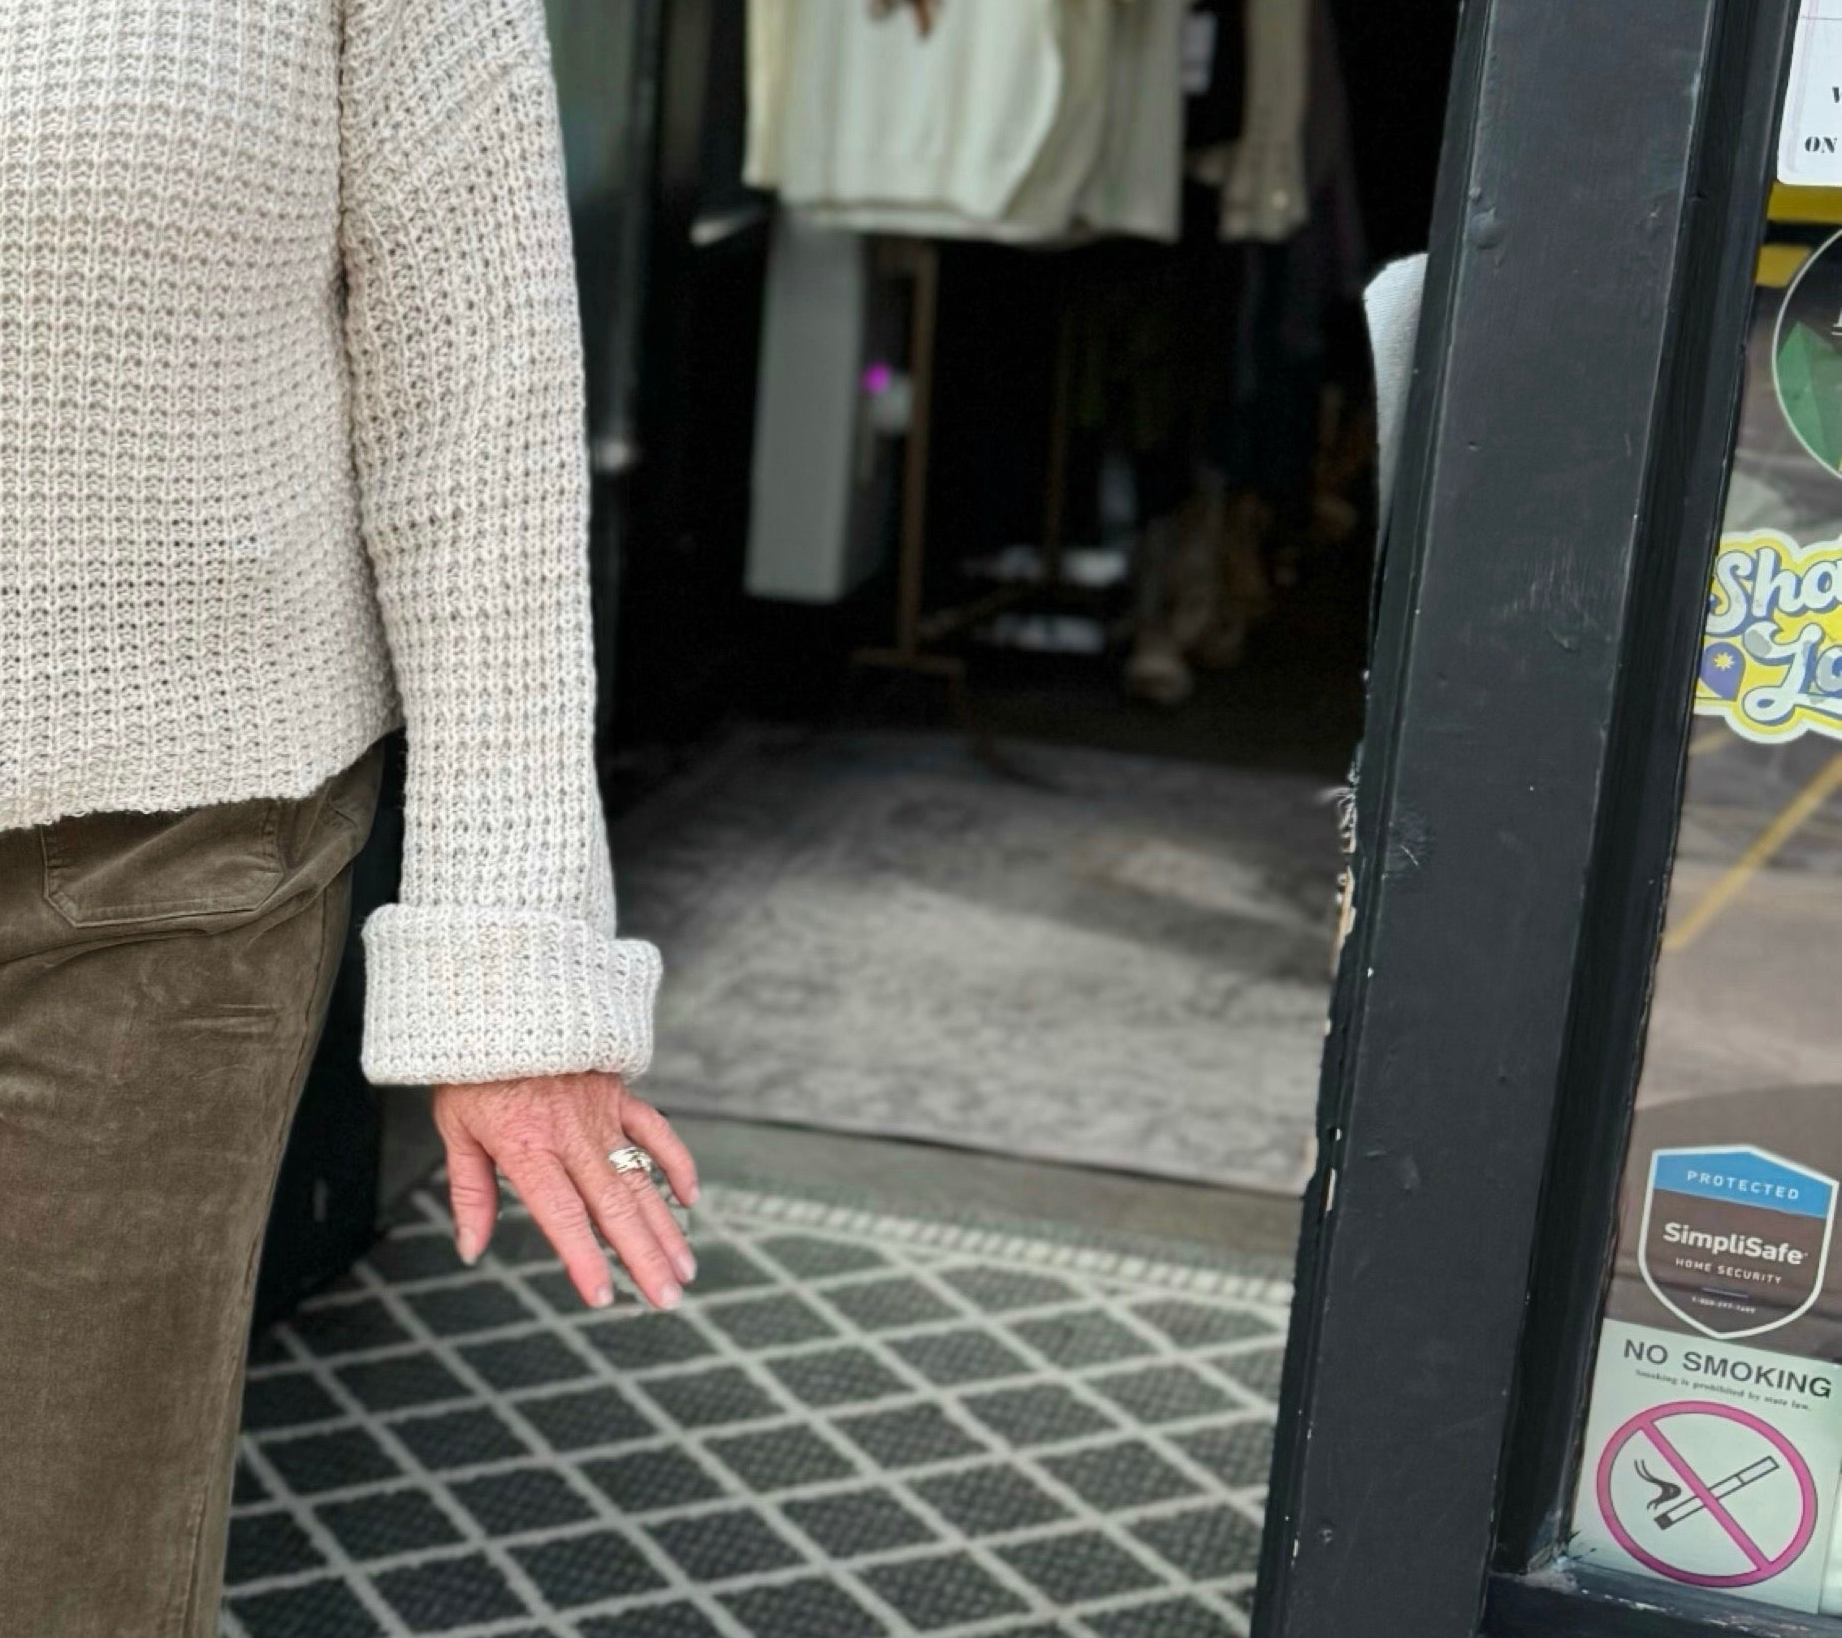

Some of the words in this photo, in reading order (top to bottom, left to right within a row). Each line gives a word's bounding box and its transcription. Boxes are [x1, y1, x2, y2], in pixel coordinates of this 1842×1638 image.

[1686, 1169, 1800, 1201] PROTECTED
[1662, 1221, 1804, 1266] SimpliSafe
[1675, 1256, 1712, 1273] HOME
[1717, 1264, 1783, 1285] SECURITY
[1623, 1338, 1669, 1366] NO
[1682, 1350, 1833, 1399] SMOKING
